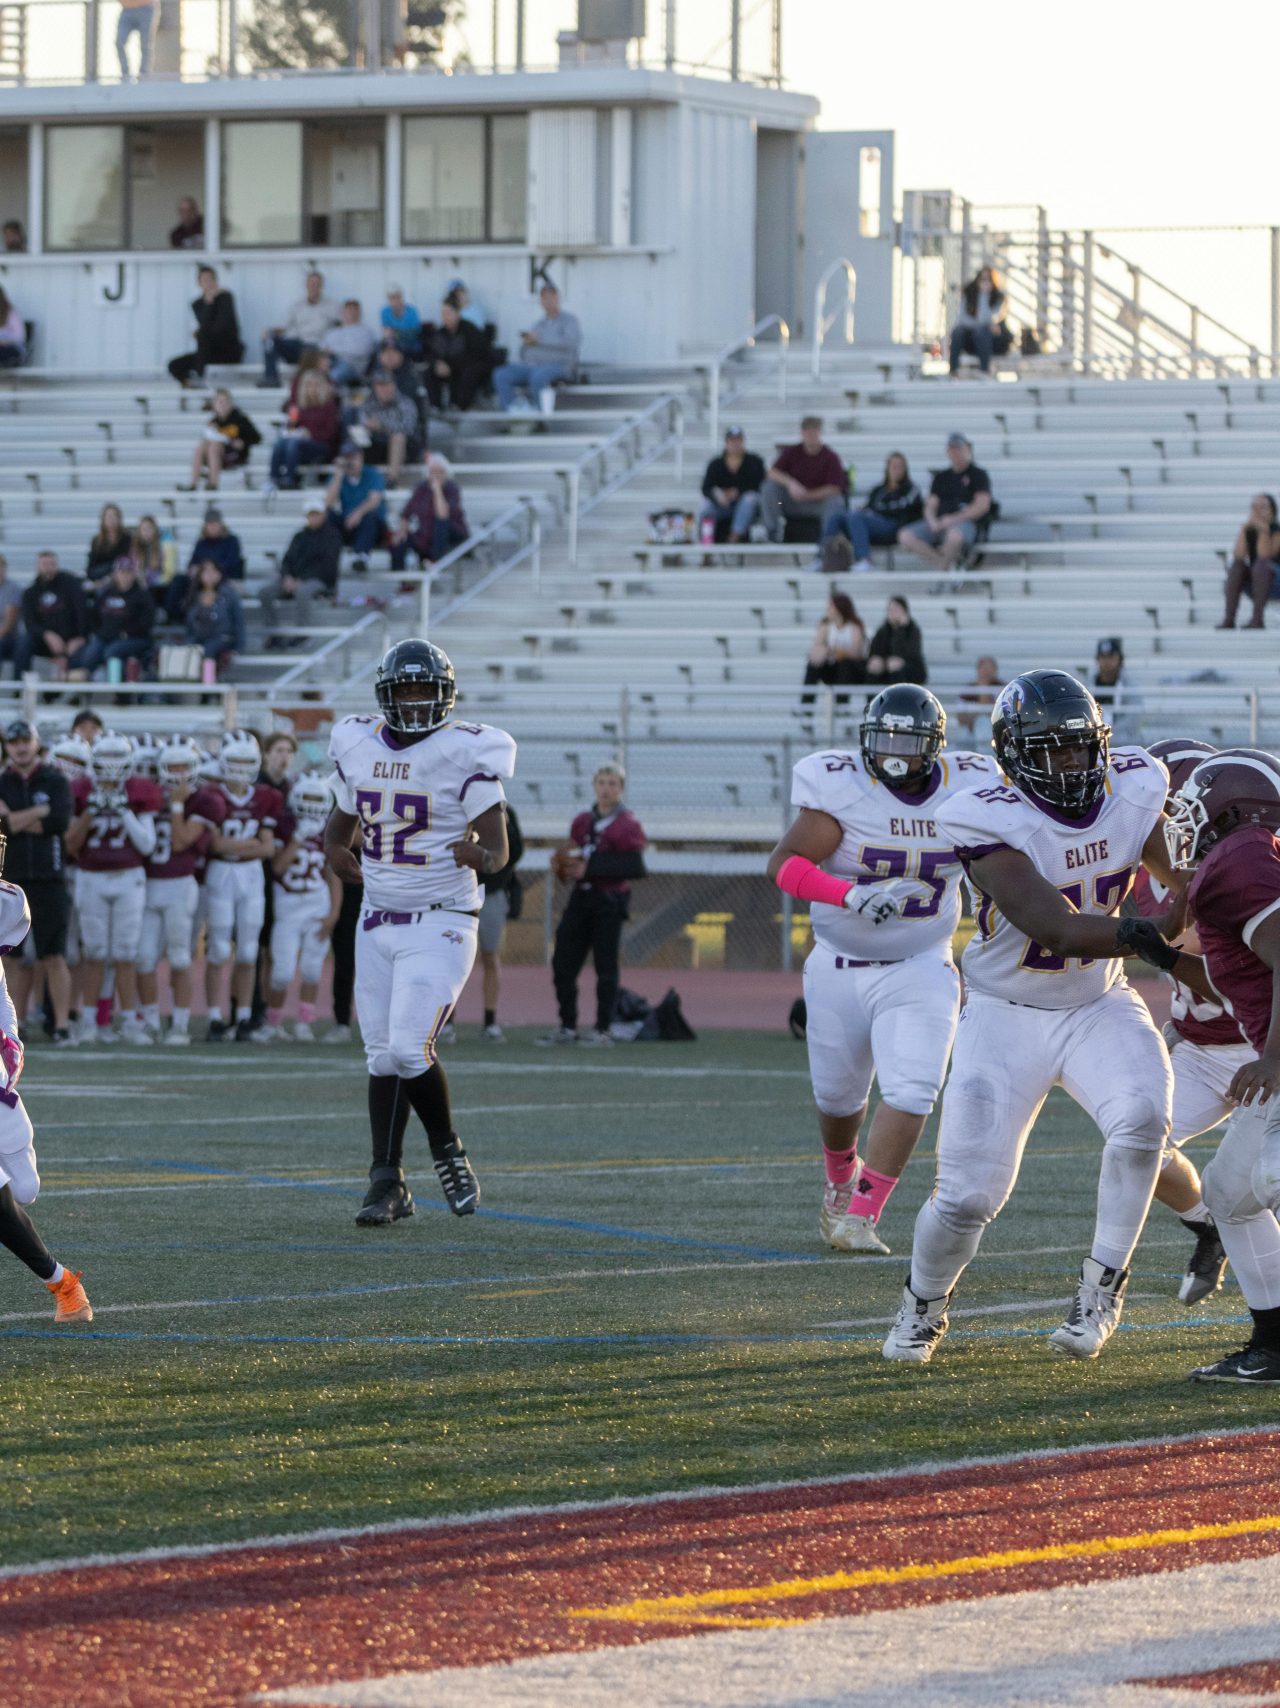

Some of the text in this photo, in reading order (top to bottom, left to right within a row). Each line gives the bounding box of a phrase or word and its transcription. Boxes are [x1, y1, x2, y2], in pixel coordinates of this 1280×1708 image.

[103, 261, 125, 301] J
[529, 254, 556, 295] K
[373, 762, 411, 780] ELITE
[355, 787, 432, 868] 62
[890, 817, 938, 838] ELITE
[1065, 839, 1109, 869] ELITE
